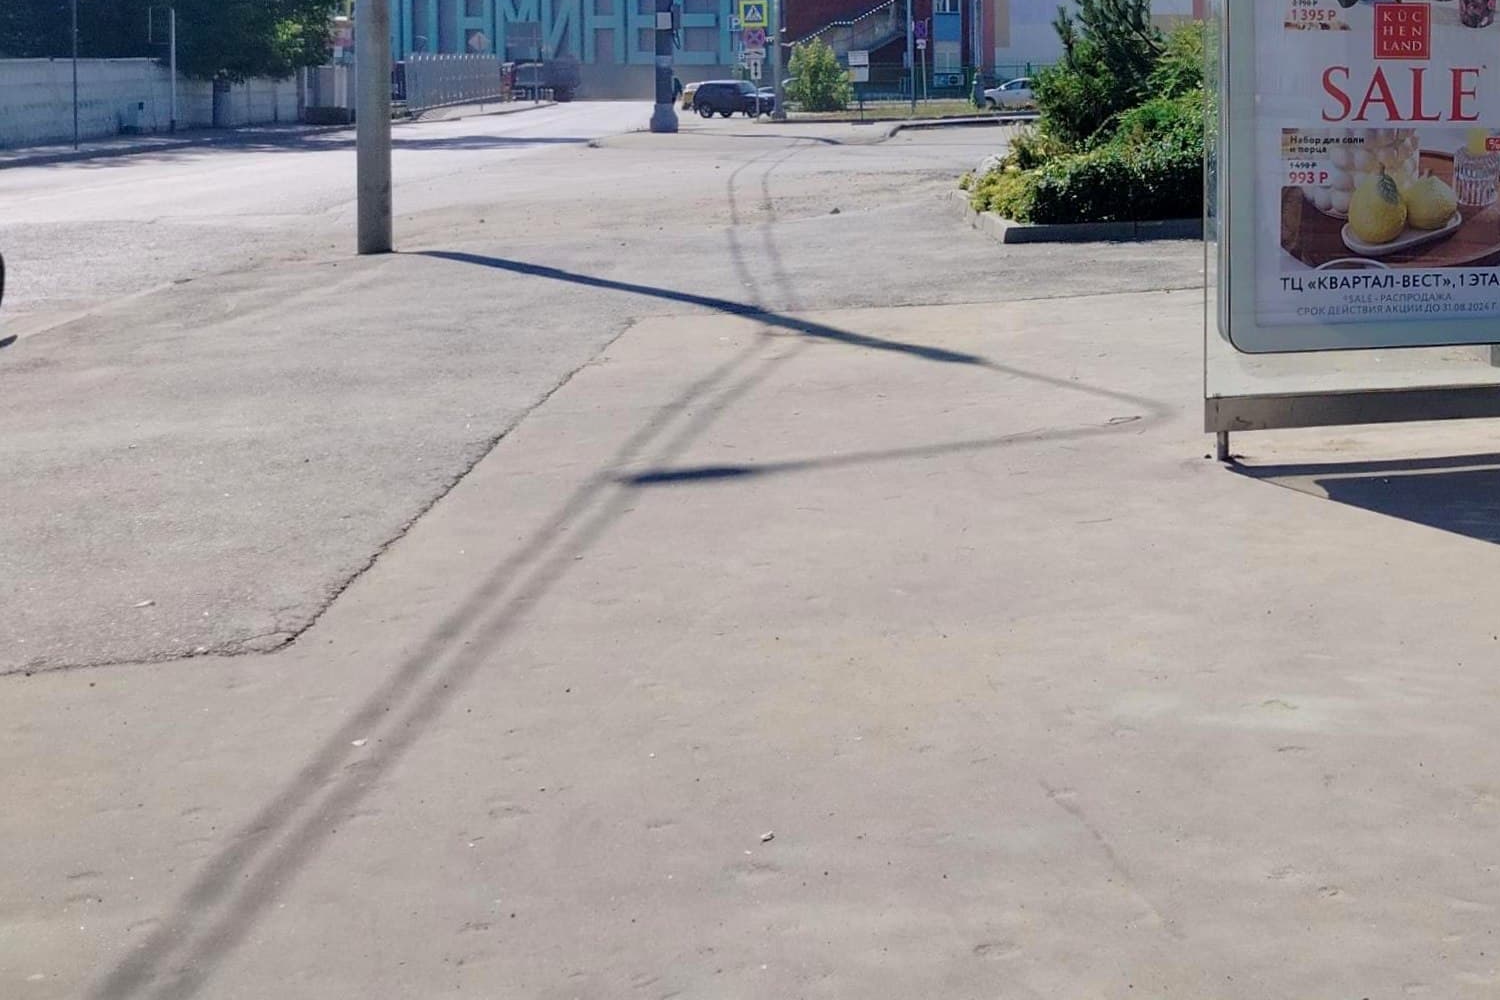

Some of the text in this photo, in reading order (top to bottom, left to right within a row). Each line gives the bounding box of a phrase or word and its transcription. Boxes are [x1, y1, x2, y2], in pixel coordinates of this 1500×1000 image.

[1383, 26, 1422, 37] HEN
[1383, 40, 1423, 51] LAND
[1290, 135, 1365, 146] Набор для соли
[1298, 146, 1327, 154] перца
[1289, 171, 1315, 184] 993
[1280, 277, 1304, 293] ТЦ
[1307, 273, 1456, 290] «КВАРТАЛ-ВЕСТ»,
[1459, 274, 1464, 285] 1
[1296, 305, 1326, 317] СРОК
[1327, 304, 1383, 316] ДЕЙСТВИЯ
[1384, 303, 1423, 315] АКЦИИ
[1424, 303, 1441, 313] ДО
